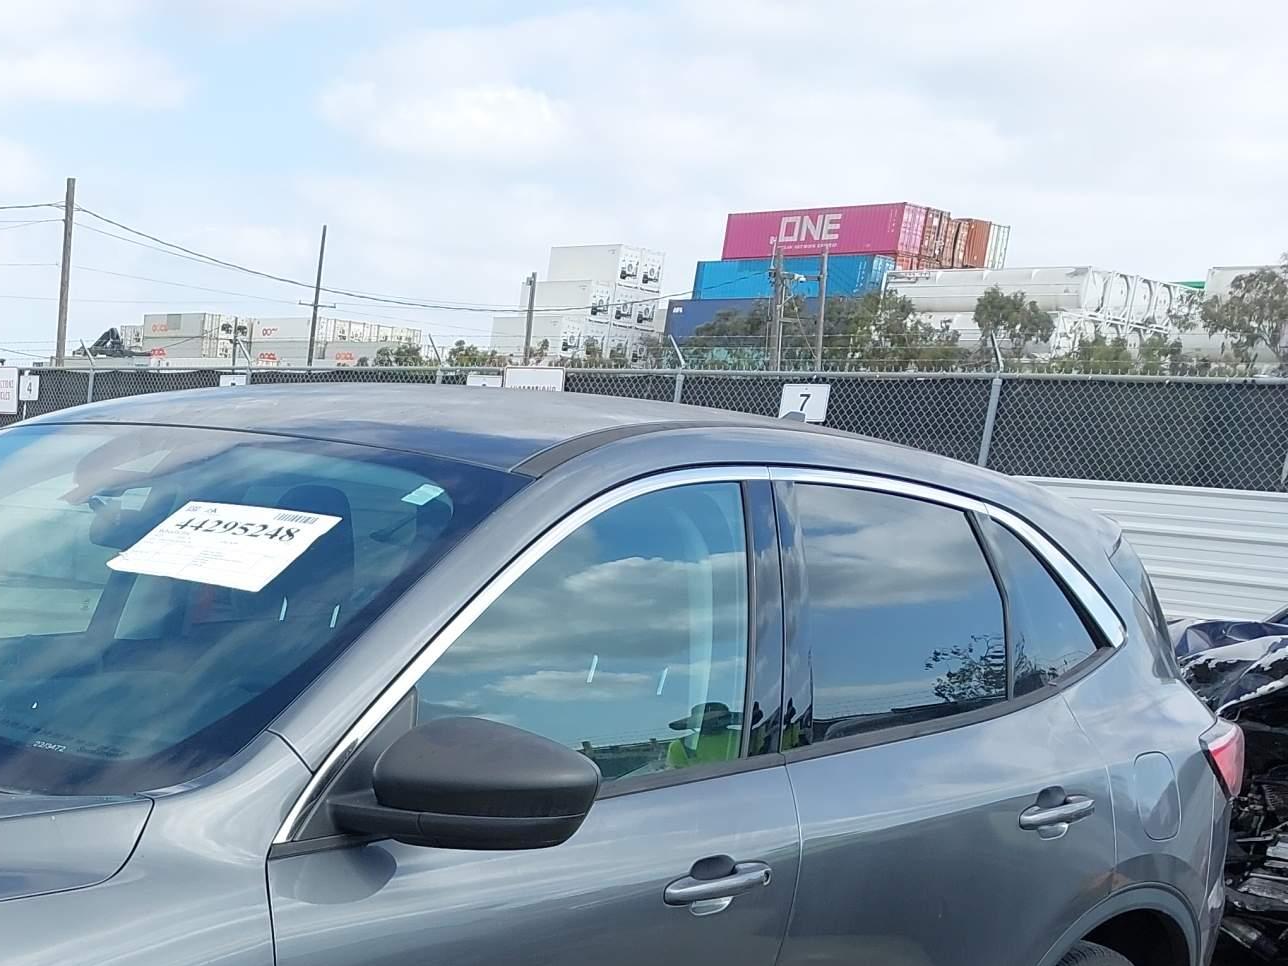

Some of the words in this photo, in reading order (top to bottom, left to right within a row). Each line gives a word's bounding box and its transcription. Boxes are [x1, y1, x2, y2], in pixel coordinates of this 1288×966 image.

[778, 213, 842, 243] ONE
[26, 381, 33, 395] 4
[799, 393, 811, 412] 7
[175, 516, 301, 542] 44295248
